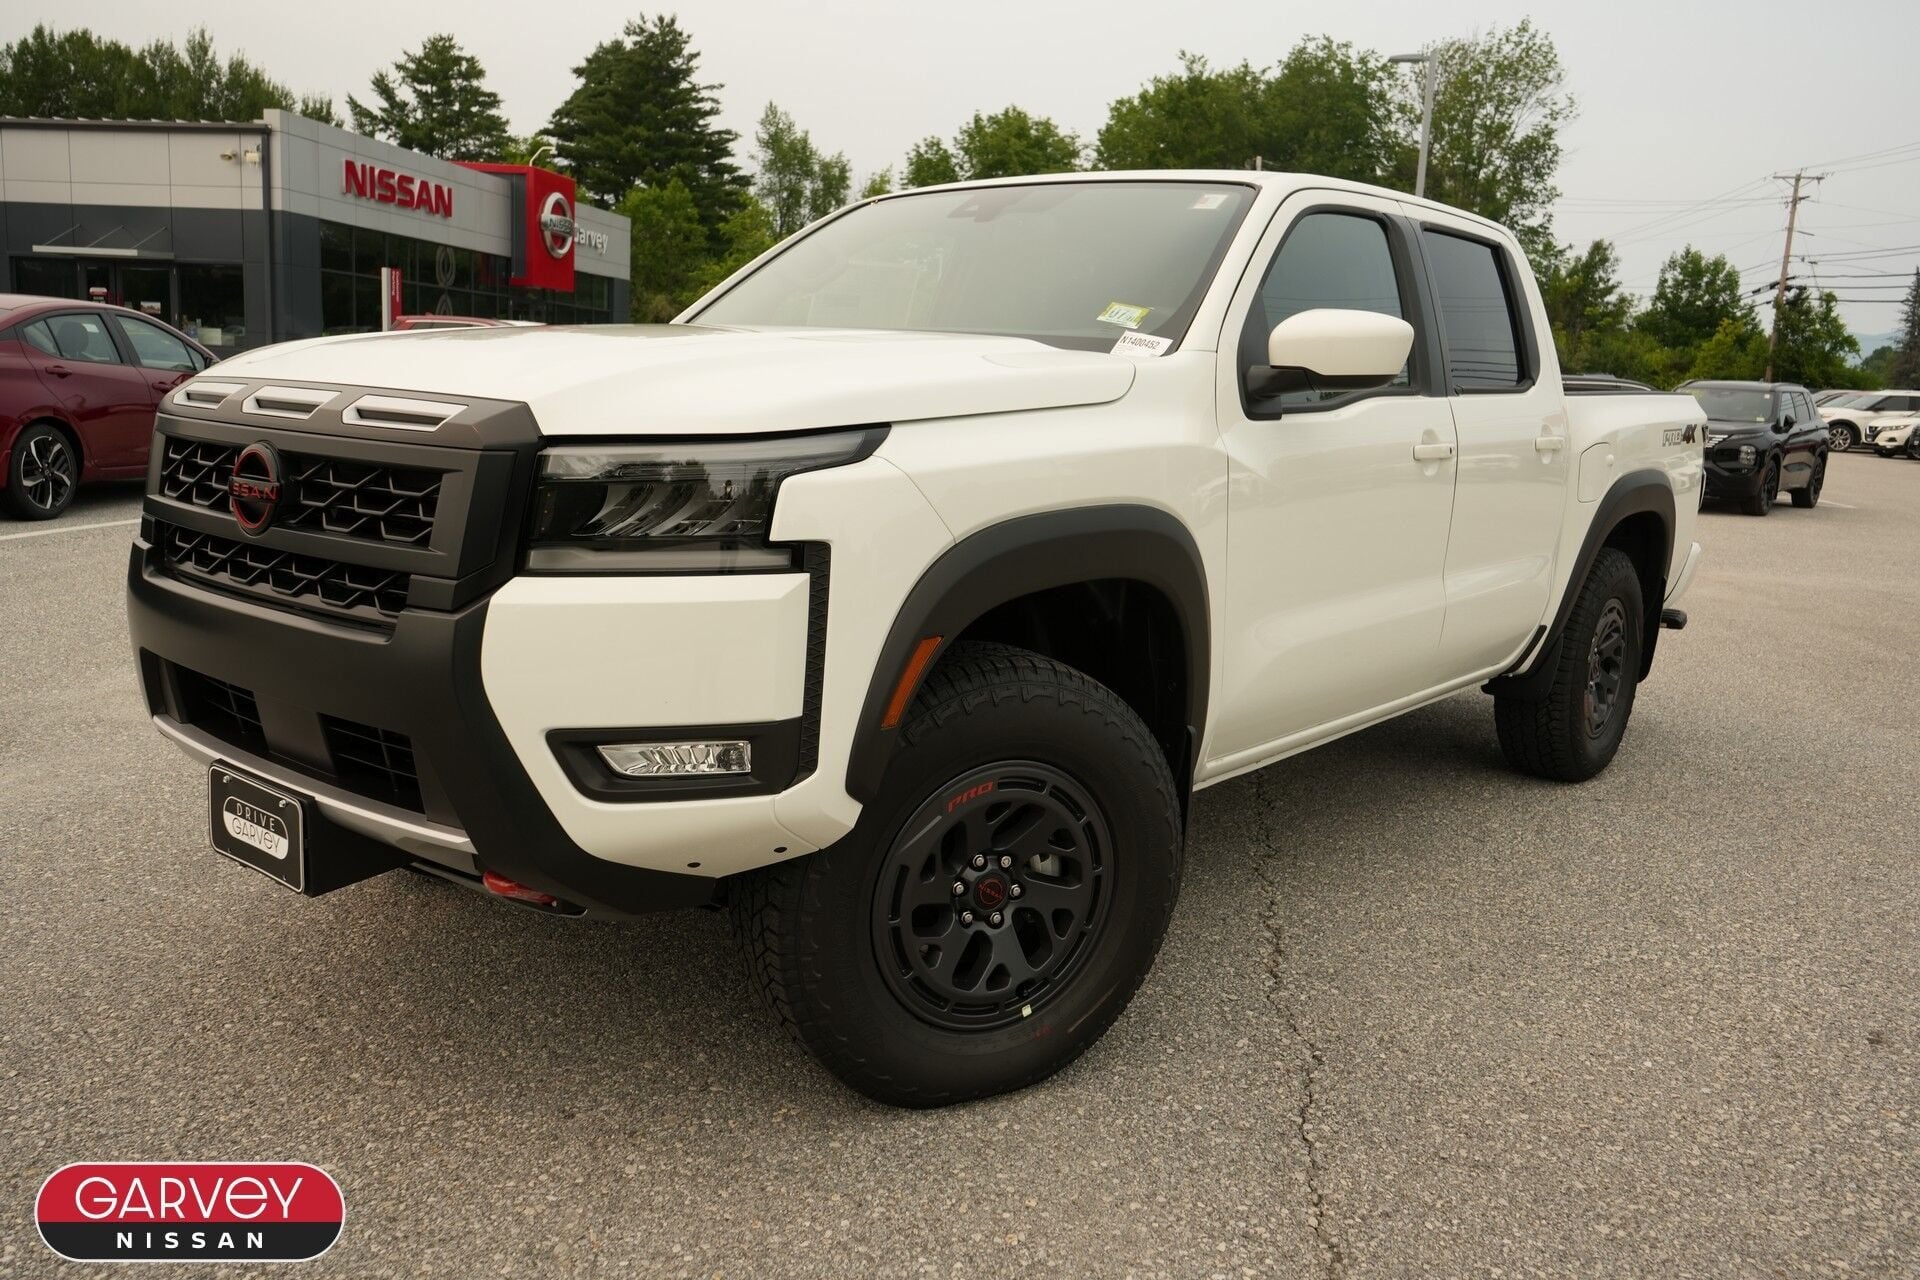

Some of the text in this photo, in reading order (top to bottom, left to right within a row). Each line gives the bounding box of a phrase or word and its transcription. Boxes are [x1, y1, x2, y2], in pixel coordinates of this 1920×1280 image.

[345, 160, 453, 218] NISSAN
[948, 780, 993, 813] PRO
[236, 802, 275, 832] DRIVE
